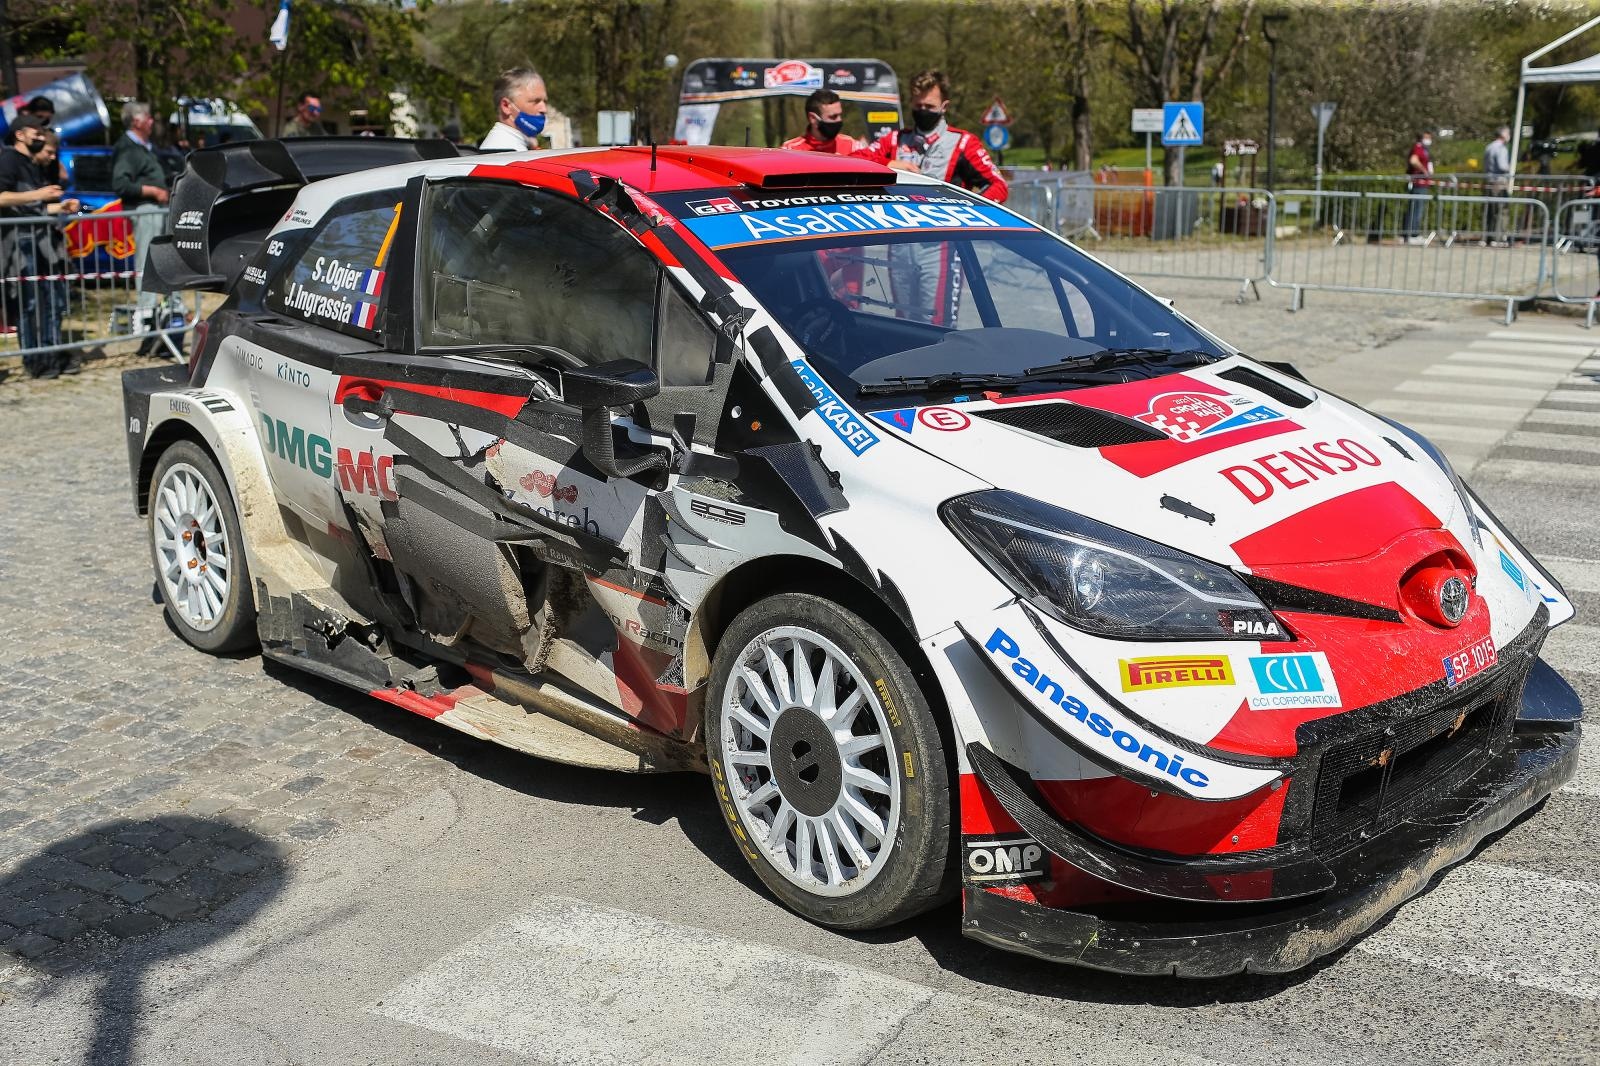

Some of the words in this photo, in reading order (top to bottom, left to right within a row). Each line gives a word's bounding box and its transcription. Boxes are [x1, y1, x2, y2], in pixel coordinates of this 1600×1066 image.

[294, 209, 308, 217] JAPAN
[694, 203, 738, 214] GR
[741, 195, 836, 210] TOYOTA
[836, 193, 911, 203] GAZOO
[910, 194, 975, 207] Racing
[291, 216, 312, 225] AIRLINES
[374, 201, 403, 267] 1
[312, 256, 363, 292] S.Ogier
[284, 282, 353, 324] J.Ingrassia
[169, 399, 191, 415] ENDLESS
[1169, 397, 1218, 414] CROATIA
[1195, 404, 1226, 418] RALLY
[259, 410, 333, 479] DMG
[1217, 438, 1382, 505] DENSO
[690, 499, 747, 523] ECS
[625, 618, 684, 649] Racin
[1233, 620, 1280, 635] PIAA
[1127, 659, 1227, 686] PIRELLI
[1452, 655, 1470, 679] SP
[1471, 639, 1496, 670] 1015
[1265, 658, 1309, 691] CCI
[984, 627, 1210, 788] Panasonic
[1252, 696, 1270, 707] CCI
[1272, 695, 1338, 706] CORPORATION
[968, 844, 1042, 874] OMP
